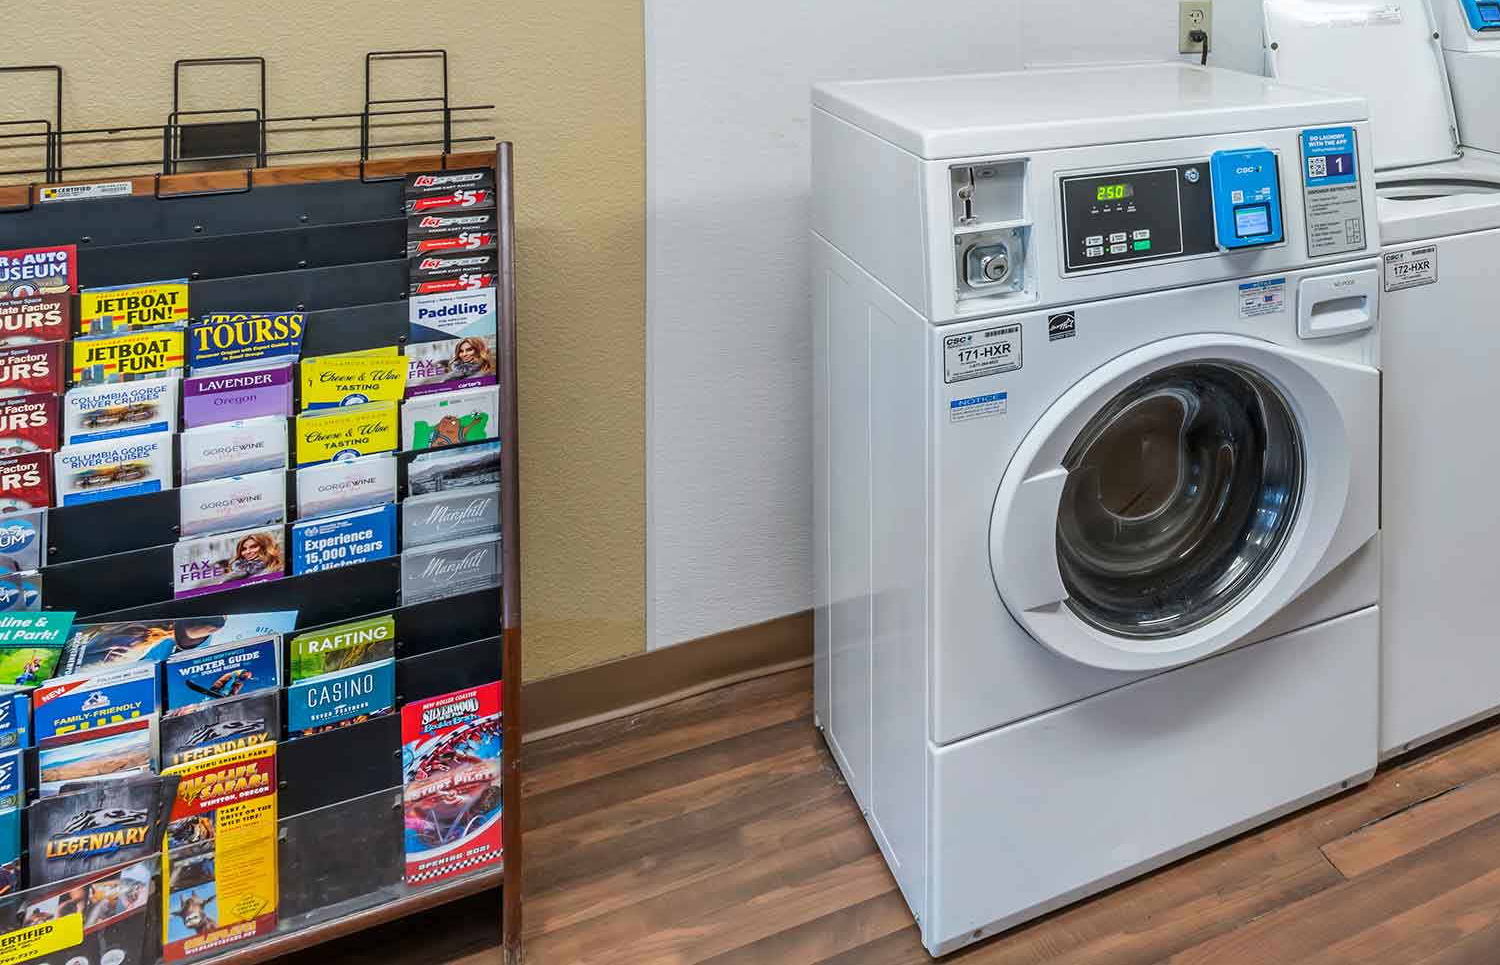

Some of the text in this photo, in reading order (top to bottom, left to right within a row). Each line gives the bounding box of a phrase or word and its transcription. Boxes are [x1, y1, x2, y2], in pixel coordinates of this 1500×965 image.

[1335, 157, 1343, 173] 1
[22, 251, 67, 265] AUTO
[1394, 260, 1430, 275] 172-HXR
[22, 303, 61, 313] Factory
[95, 292, 179, 314] JETBOAT
[418, 303, 488, 319] Paddling
[0, 310, 62, 330] URS
[127, 306, 172, 324] FUN!
[946, 337, 966, 346] CSC
[8, 353, 48, 364] Factory
[86, 339, 171, 362] JETBOAT
[958, 343, 1011, 362] 171-HXR
[118, 355, 164, 373] FUN!
[409, 359, 433, 370] TAX
[320, 369, 401, 383] Cheese & Wine
[408, 367, 444, 380] FREE
[200, 374, 272, 391] LAVENDER
[71, 385, 167, 405] COLUMBIA GORGE
[80, 392, 160, 411] RIVER CRUISES
[214, 395, 256, 406] Oregon
[5, 403, 46, 414] Factory
[345, 428, 352, 437] &
[357, 421, 389, 435] Wine
[324, 437, 369, 449] TASTING
[62, 443, 158, 464] COLUMBIA GORGE
[71, 451, 150, 469] RIVER CRUISES
[305, 529, 373, 551] Experience
[305, 540, 383, 564] 15,000 Years
[180, 559, 210, 573] TAX
[180, 569, 223, 583] FREE
[35, 617, 48, 627] &
[12, 629, 60, 640] Park!
[309, 626, 388, 653] RAFTING
[179, 651, 260, 676] WINTER GUIDE
[41, 686, 66, 702] NEW
[308, 674, 373, 708] CASINO
[54, 701, 142, 726] FAMILY-FRIENDLY
[422, 697, 479, 725] SILVERWOOD
[239, 786, 269, 797] OREGON
[47, 825, 150, 858] LEGENDARY
